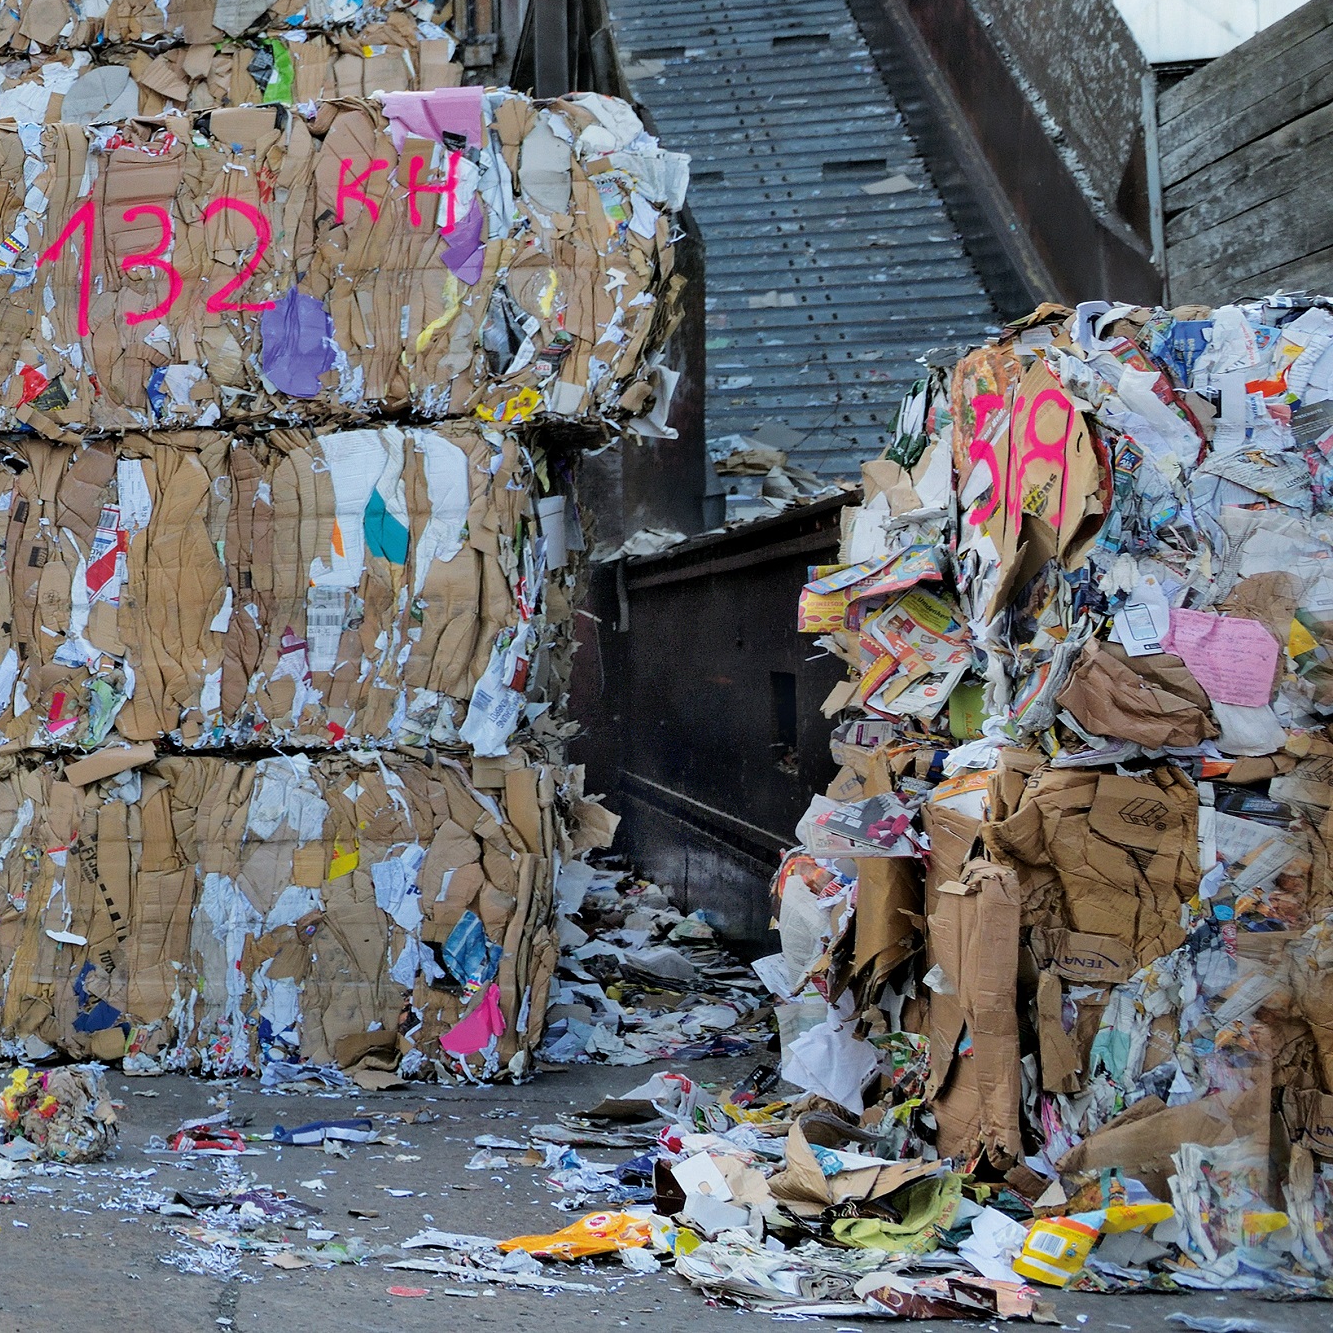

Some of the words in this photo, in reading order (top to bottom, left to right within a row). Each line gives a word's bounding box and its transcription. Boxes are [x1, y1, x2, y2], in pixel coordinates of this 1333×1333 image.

[36, 195, 276, 337] 132
[336, 150, 463, 235] KH
[1025, 473, 1057, 508] rtens
[1063, 956, 1104, 969] TENA
